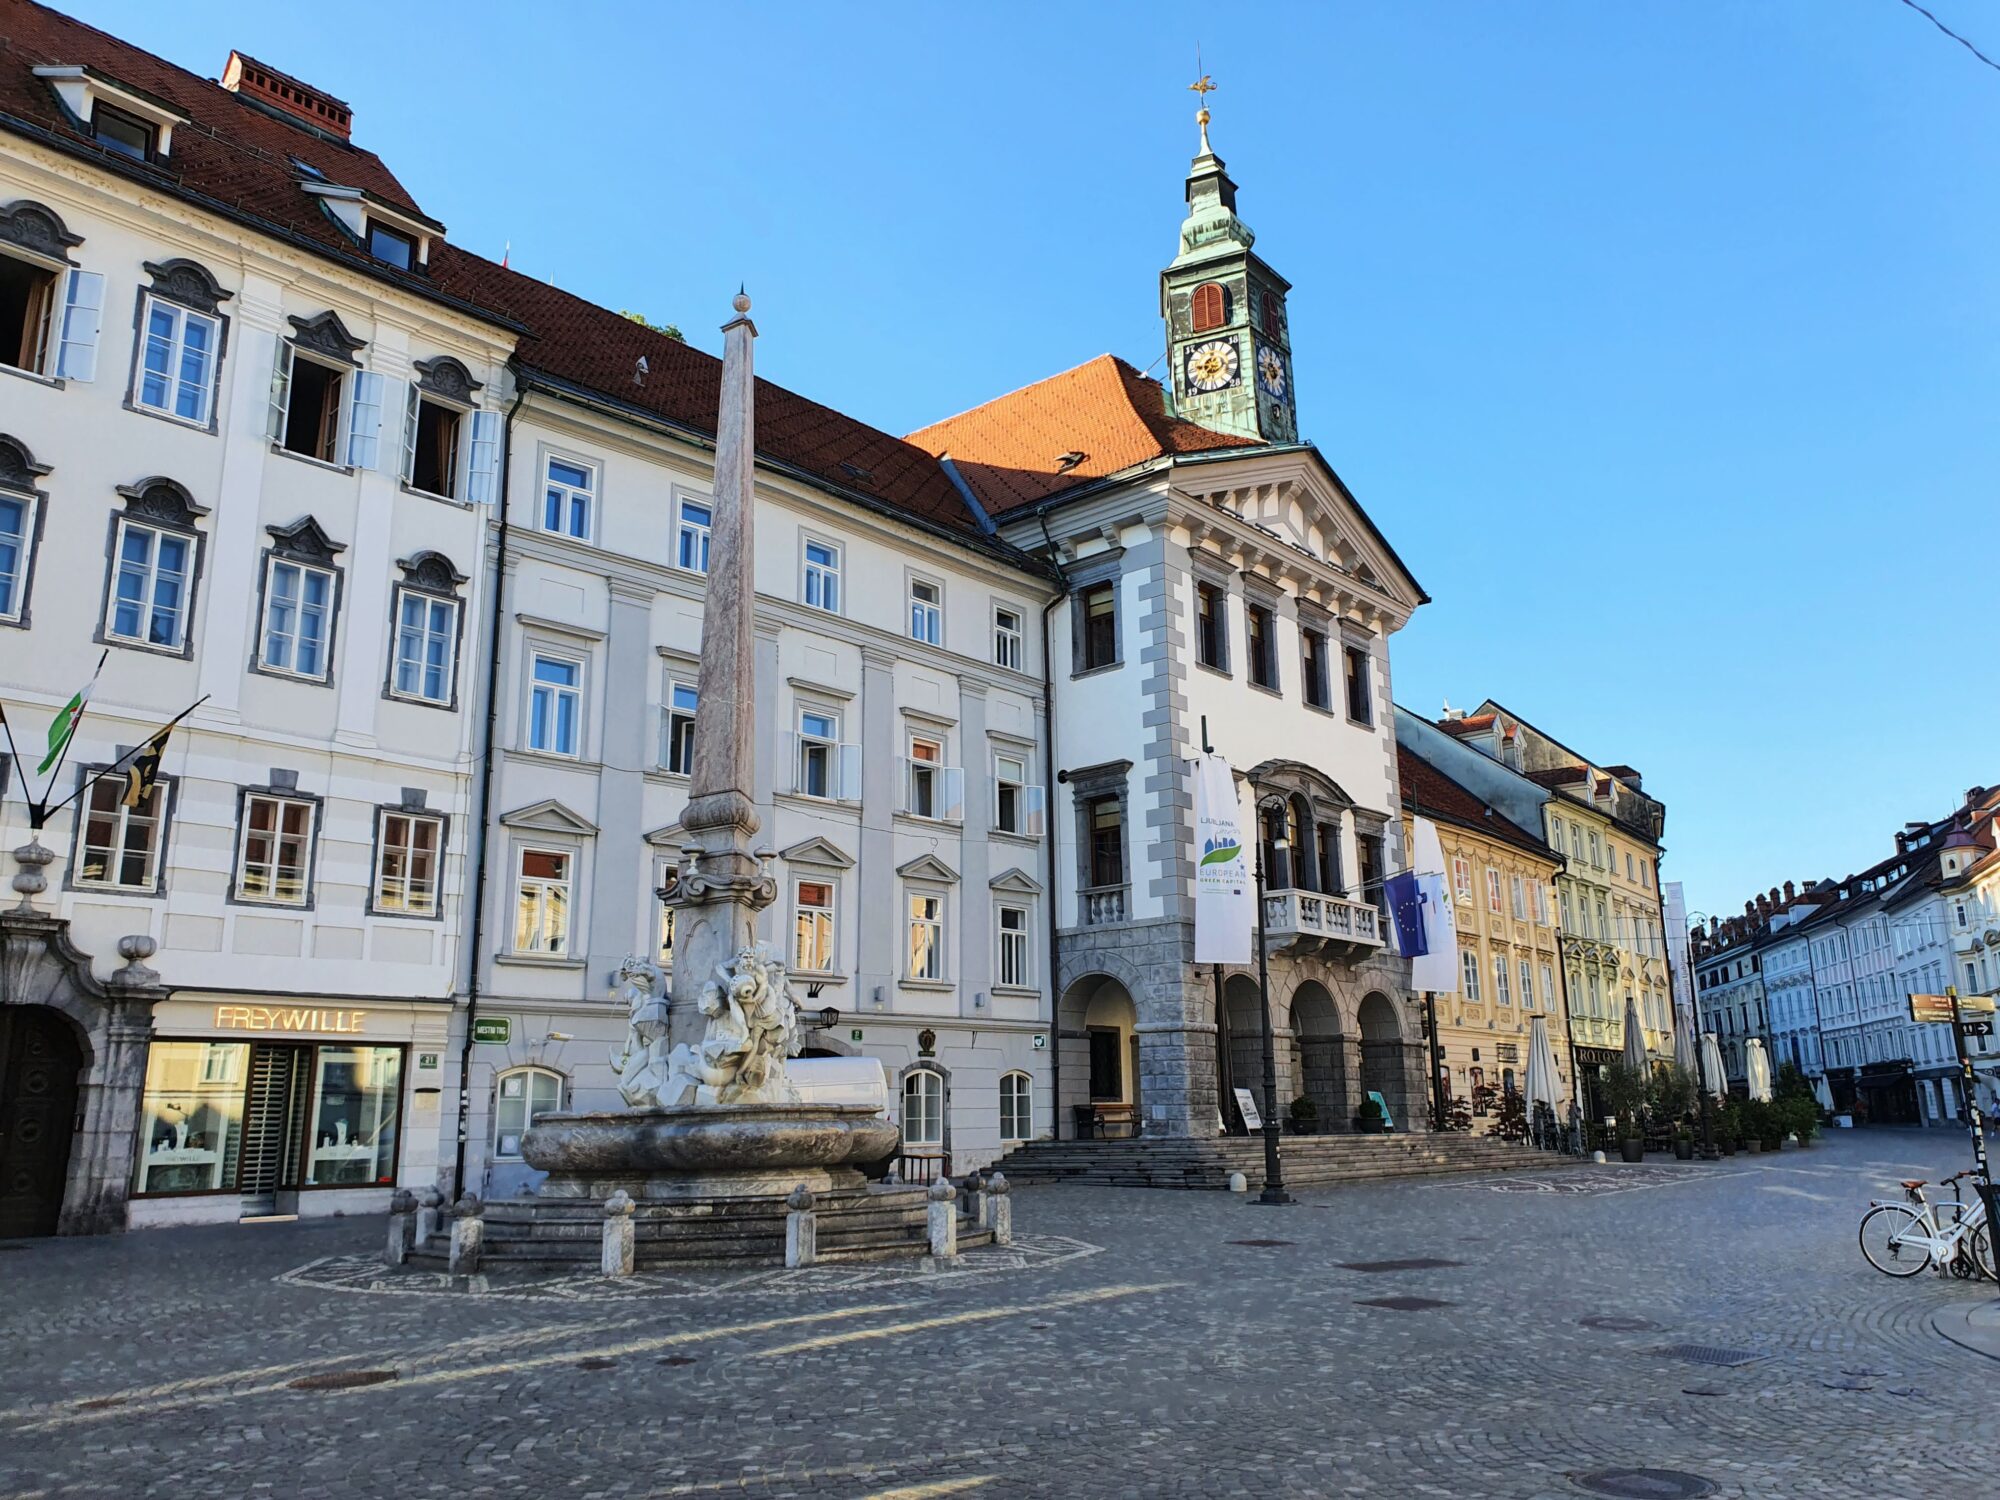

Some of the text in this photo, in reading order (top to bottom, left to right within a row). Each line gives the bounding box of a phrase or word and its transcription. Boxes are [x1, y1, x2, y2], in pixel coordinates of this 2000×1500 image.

[1228, 335, 1239, 345] 18
[1185, 345, 1196, 355] 17
[1187, 387, 1198, 397] 19
[1200, 868, 1246, 878] EUROPEAN
[216, 1006, 367, 1033] FREYWILLE
